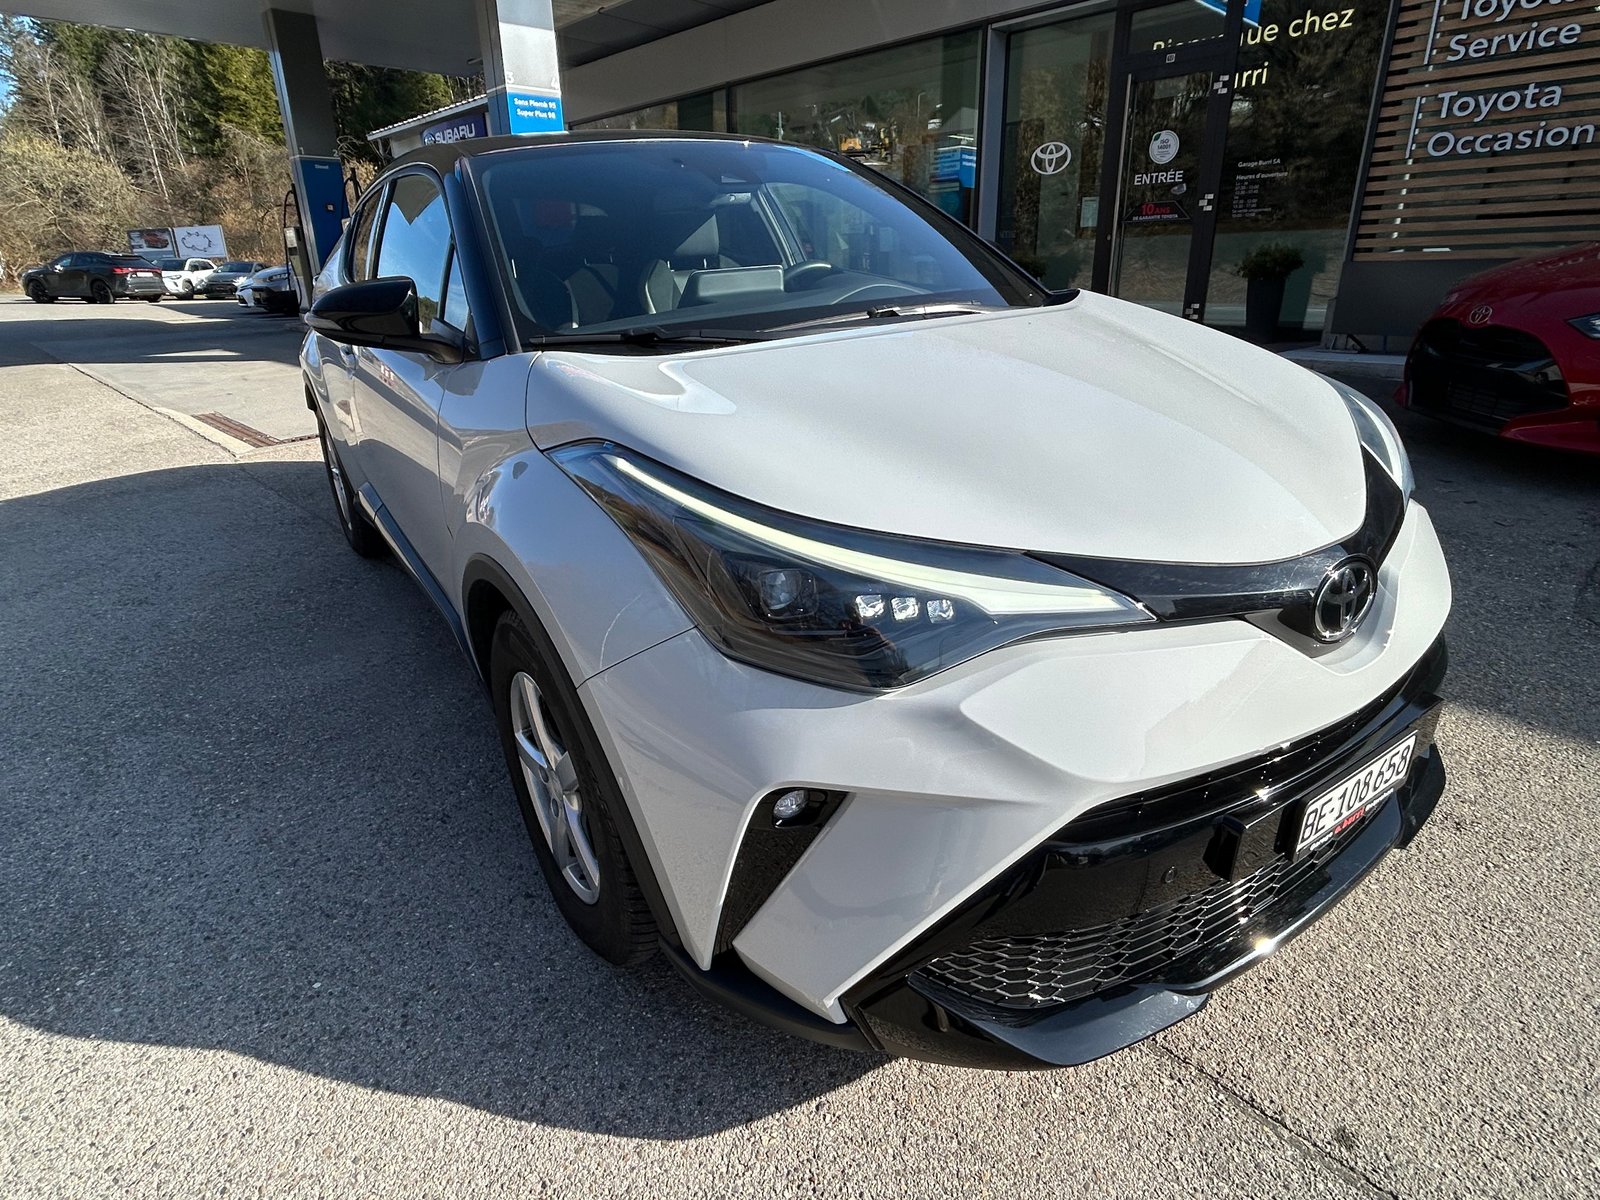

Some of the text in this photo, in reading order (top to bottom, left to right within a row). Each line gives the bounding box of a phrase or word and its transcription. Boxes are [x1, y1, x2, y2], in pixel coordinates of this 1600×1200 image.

[1460, 0, 1576, 22] Toy
[1288, 8, 1355, 38] chez
[1446, 22, 1582, 62] Service
[516, 108, 534, 118] Super
[1438, 82, 1563, 122] Toyota
[434, 123, 476, 144] SUBARU
[1427, 121, 1596, 157] Occasion
[1134, 168, 1184, 186] ENTRÉE
[1142, 203, 1155, 215] 10
